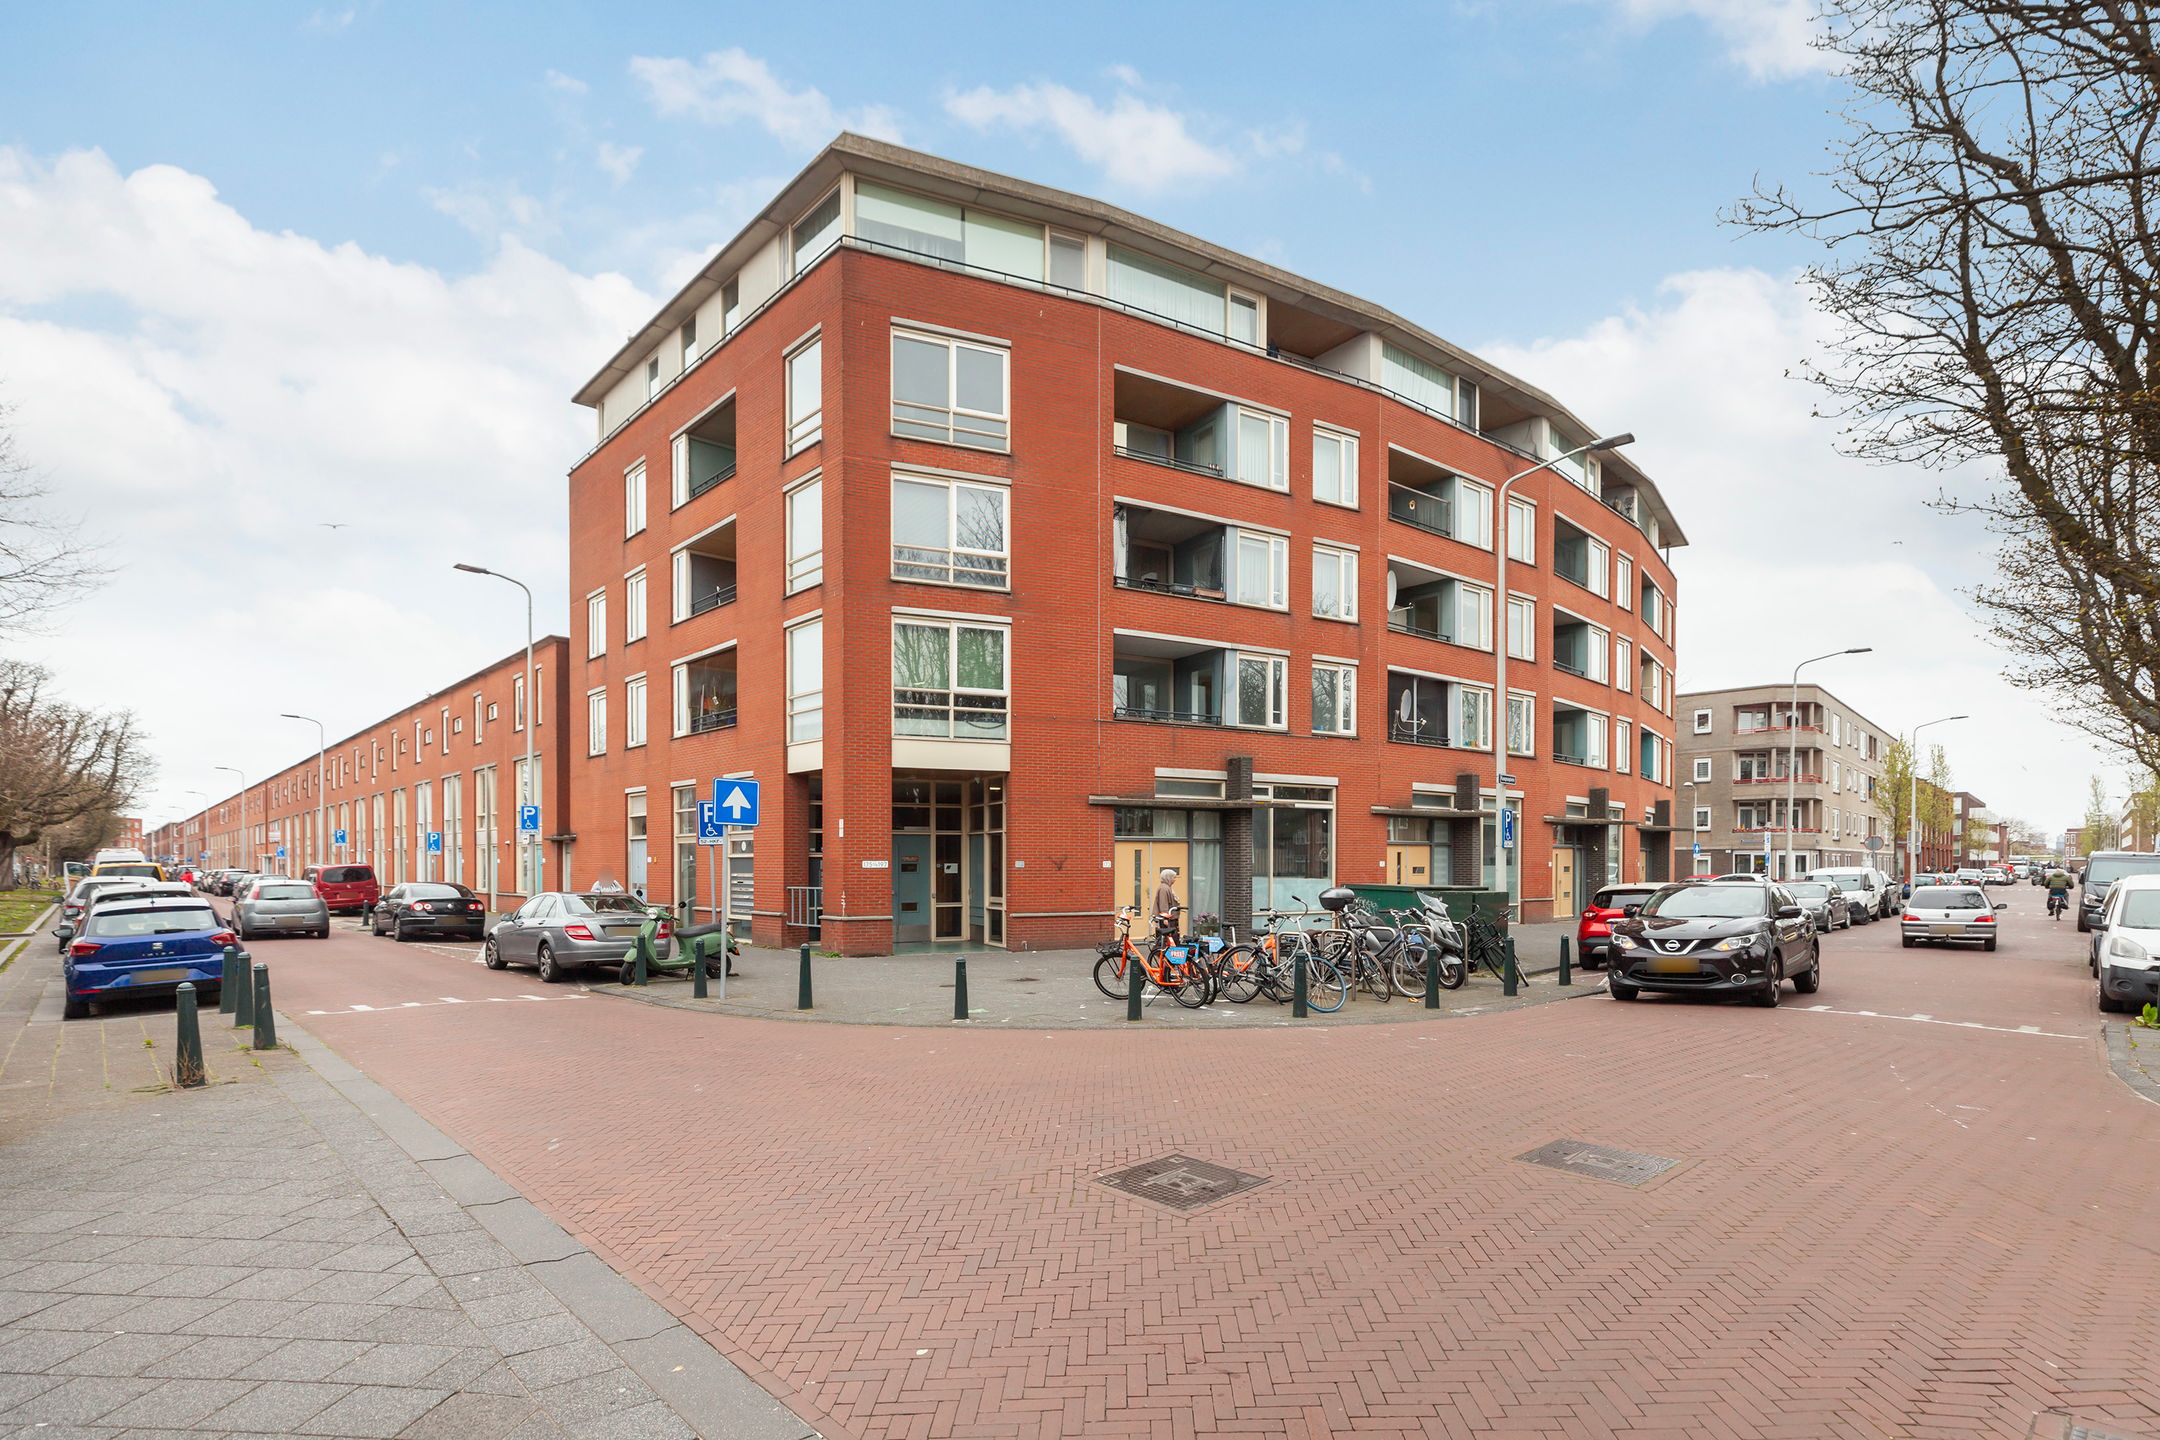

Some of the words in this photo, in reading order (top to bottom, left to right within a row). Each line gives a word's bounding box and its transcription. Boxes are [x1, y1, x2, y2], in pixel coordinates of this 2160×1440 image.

[523, 807, 536, 819] P
[1505, 811, 1511, 828] P
[337, 830, 344, 838] P
[430, 833, 438, 843] P
